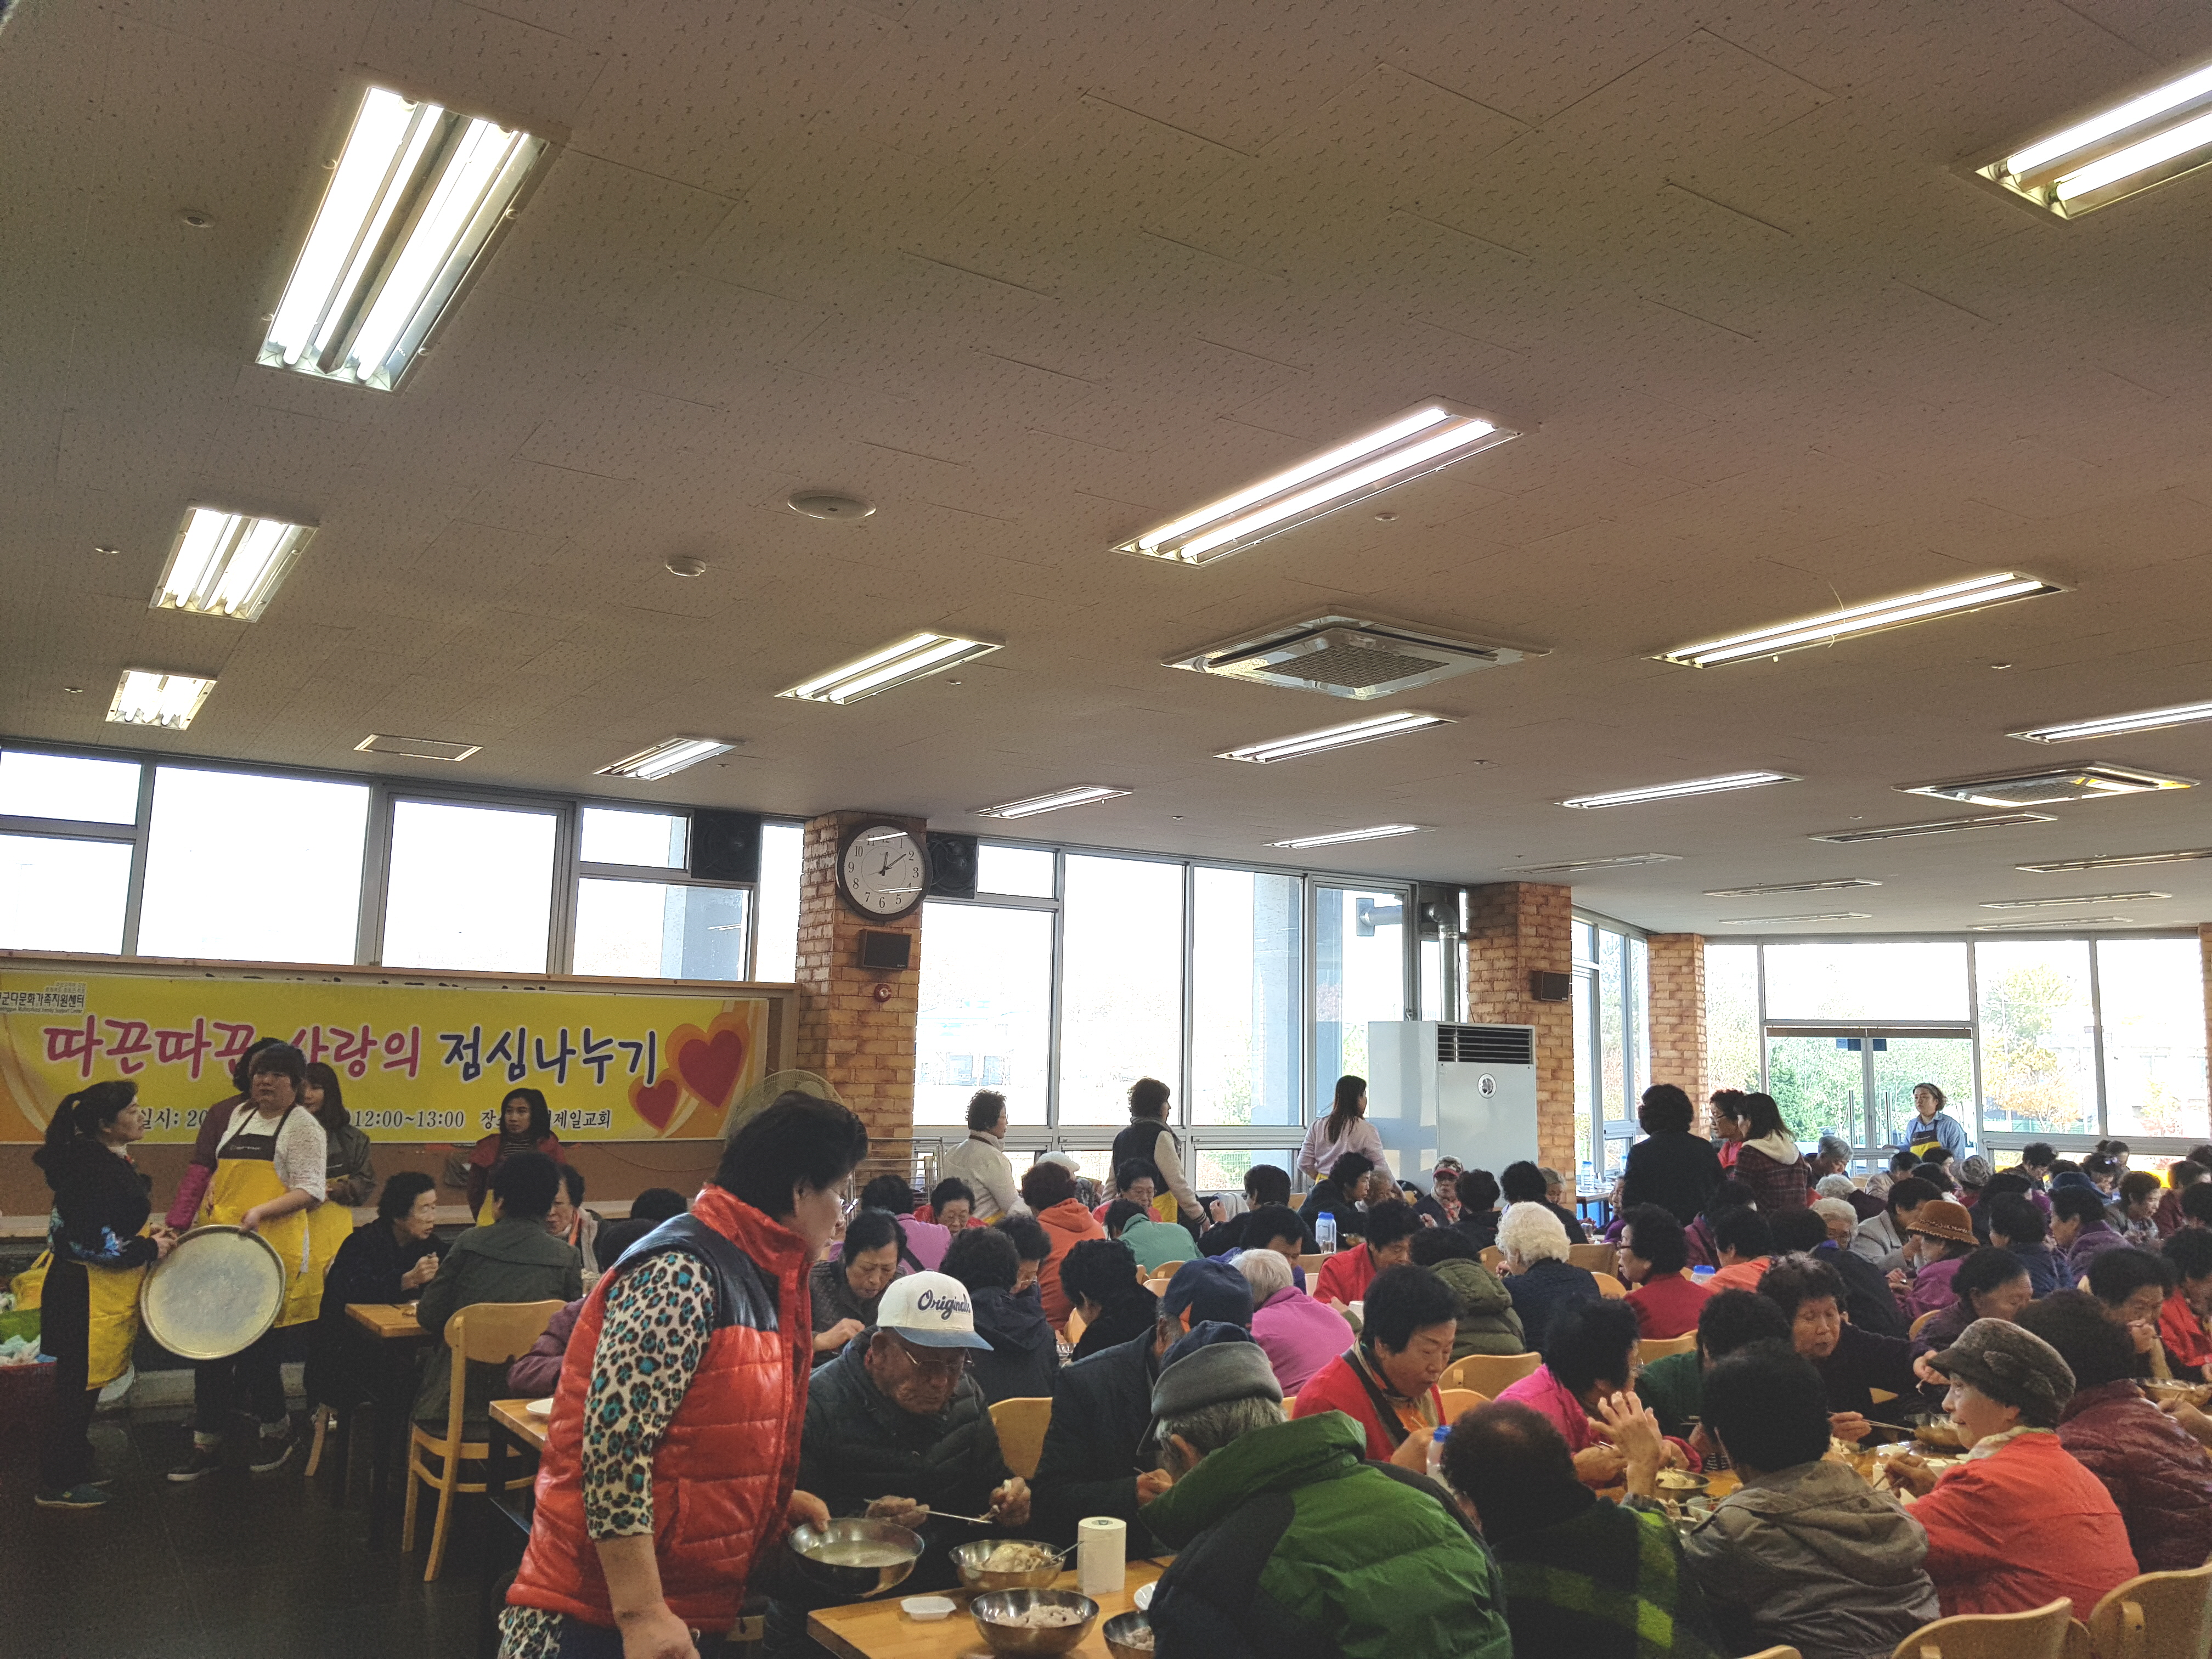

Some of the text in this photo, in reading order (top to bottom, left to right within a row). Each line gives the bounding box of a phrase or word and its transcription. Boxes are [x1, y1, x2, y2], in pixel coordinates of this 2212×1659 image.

[900, 838, 903, 849] 1
[855, 845, 863, 857] 10
[909, 850, 915, 861] 2
[848, 861, 854, 873] 9
[912, 867, 919, 878] 3
[853, 878, 859, 889] 8
[865, 891, 871, 902] 7
[879, 896, 885, 909] 6
[895, 894, 901, 905] 5
[0, 992, 84, 1008] 군다문화가족지원센터
[43, 1014, 255, 1079] 따끈따끈
[439, 1025, 656, 1085] 점심나누기
[354, 1110, 464, 1127] 12:00~13:00
[917, 1289, 971, 1321] Originals
